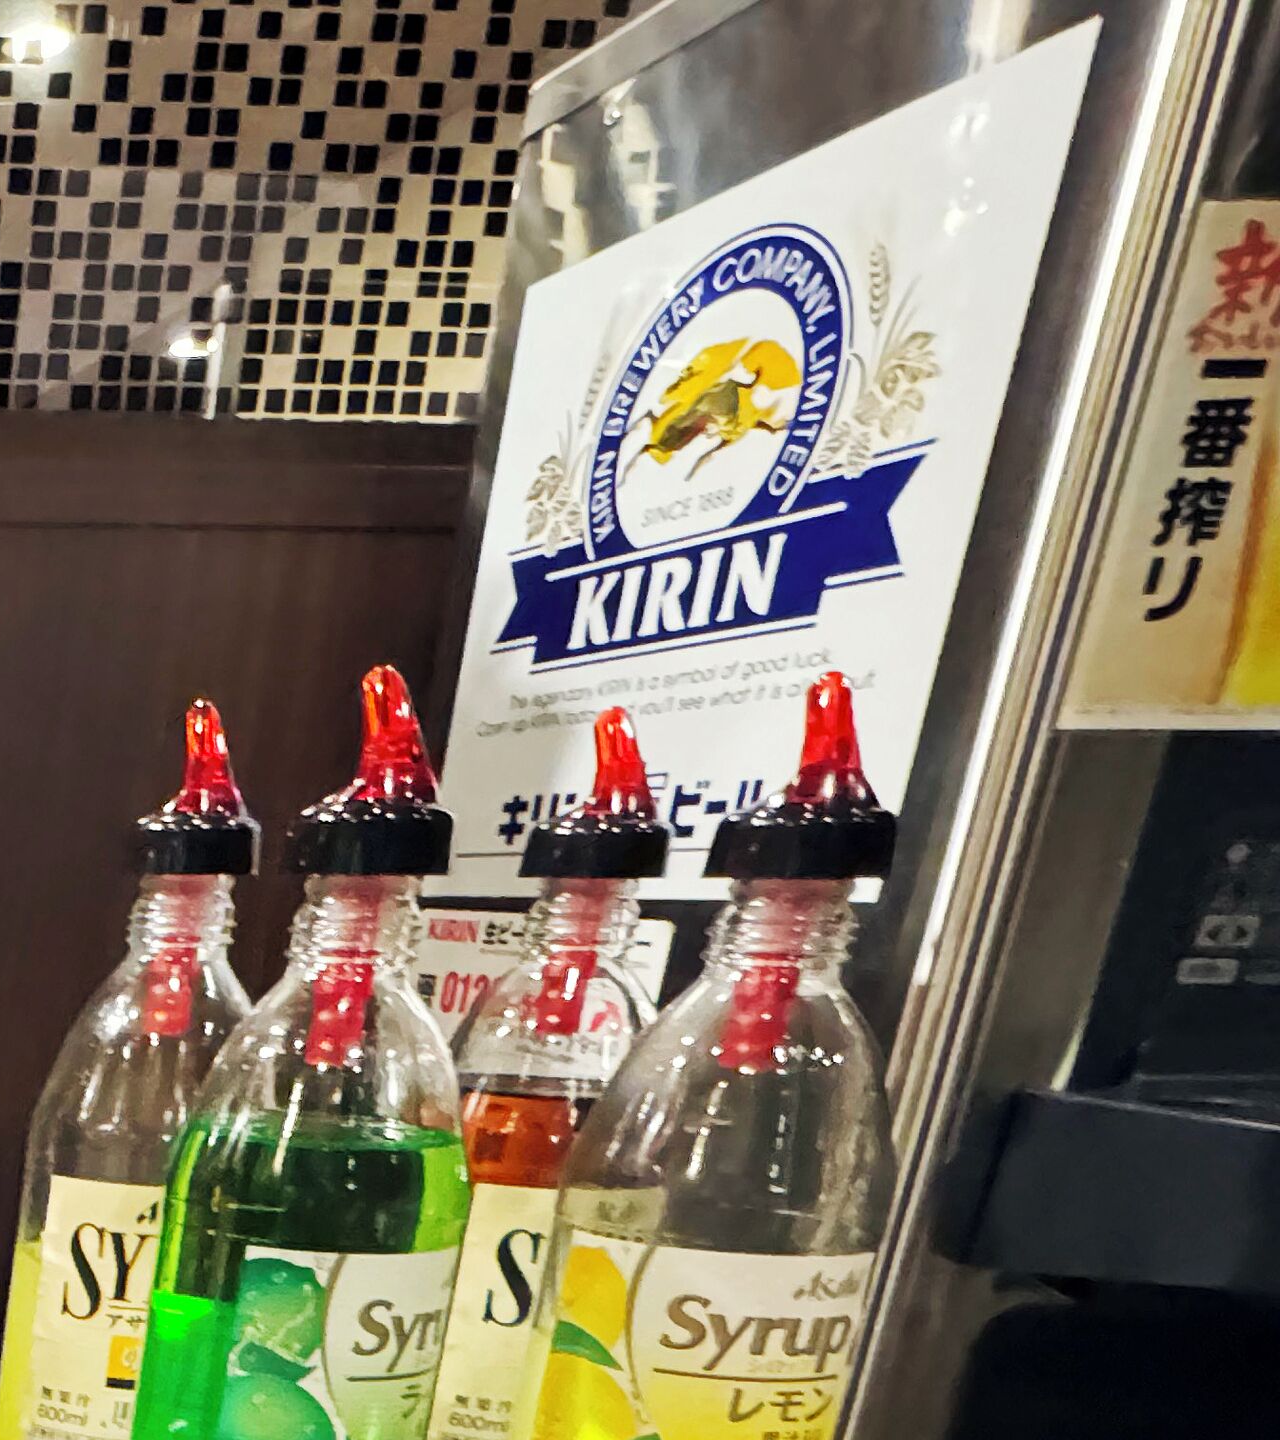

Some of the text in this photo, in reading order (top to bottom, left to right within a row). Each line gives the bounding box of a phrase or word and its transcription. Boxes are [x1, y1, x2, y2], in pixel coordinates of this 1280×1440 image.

[592, 246, 838, 543] KIRIN BREWERY COMPANY, LIMITED
[1142, 359, 1269, 621] 一番搾り
[566, 532, 788, 650] KIRIN
[660, 1294, 852, 1373] Syrup
[728, 1387, 833, 1423] レモン
